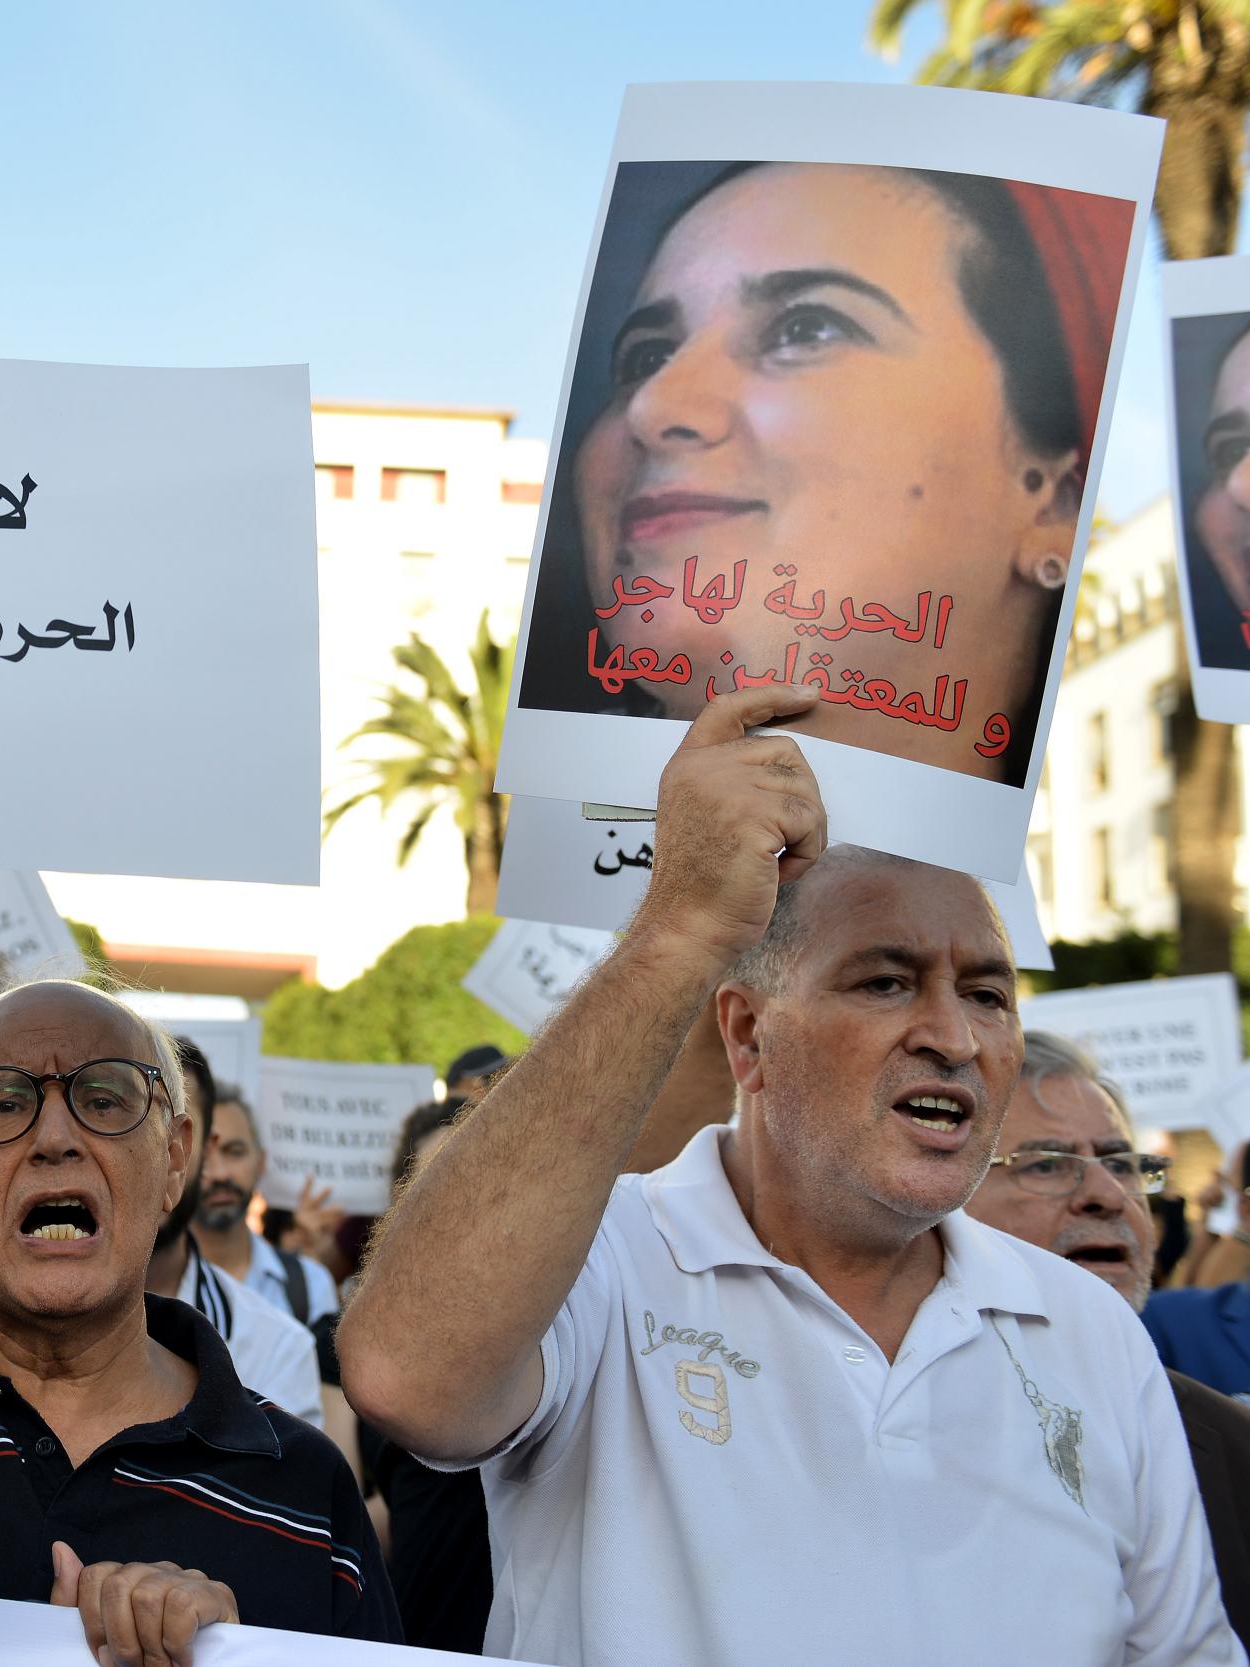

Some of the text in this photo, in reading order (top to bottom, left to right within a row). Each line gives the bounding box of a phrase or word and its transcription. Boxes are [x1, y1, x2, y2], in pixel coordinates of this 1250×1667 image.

[593, 555, 954, 649] الحرية لهاجر
[586, 626, 692, 694] معها
[974, 712, 1012, 758] و
[640, 1309, 761, 1379] League
[674, 1359, 733, 1446] 9
